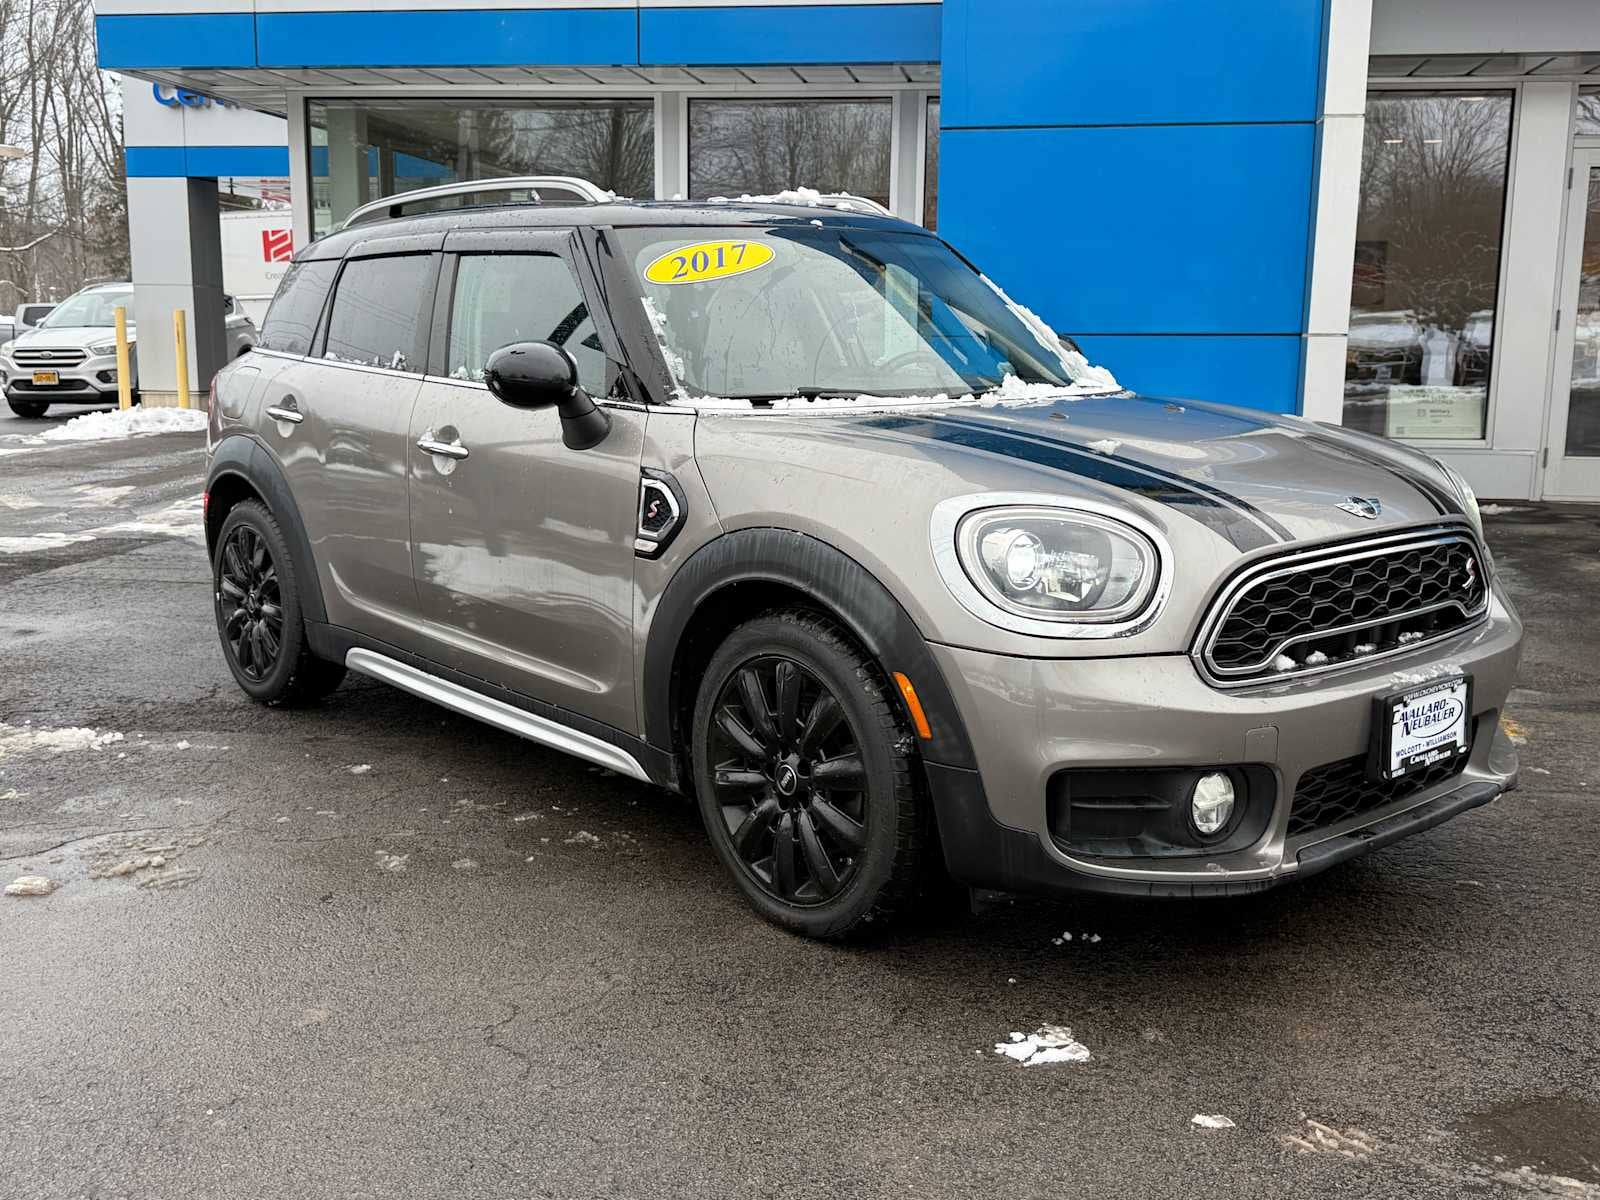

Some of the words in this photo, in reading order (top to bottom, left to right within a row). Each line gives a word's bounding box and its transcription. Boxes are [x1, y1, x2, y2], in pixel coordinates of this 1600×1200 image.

[670, 243, 748, 280] 2017
[1401, 707, 1455, 738] NEUBAUER
[1395, 743, 1421, 758] WOLCOTT
[1426, 731, 1457, 747] WILLIAMSON
